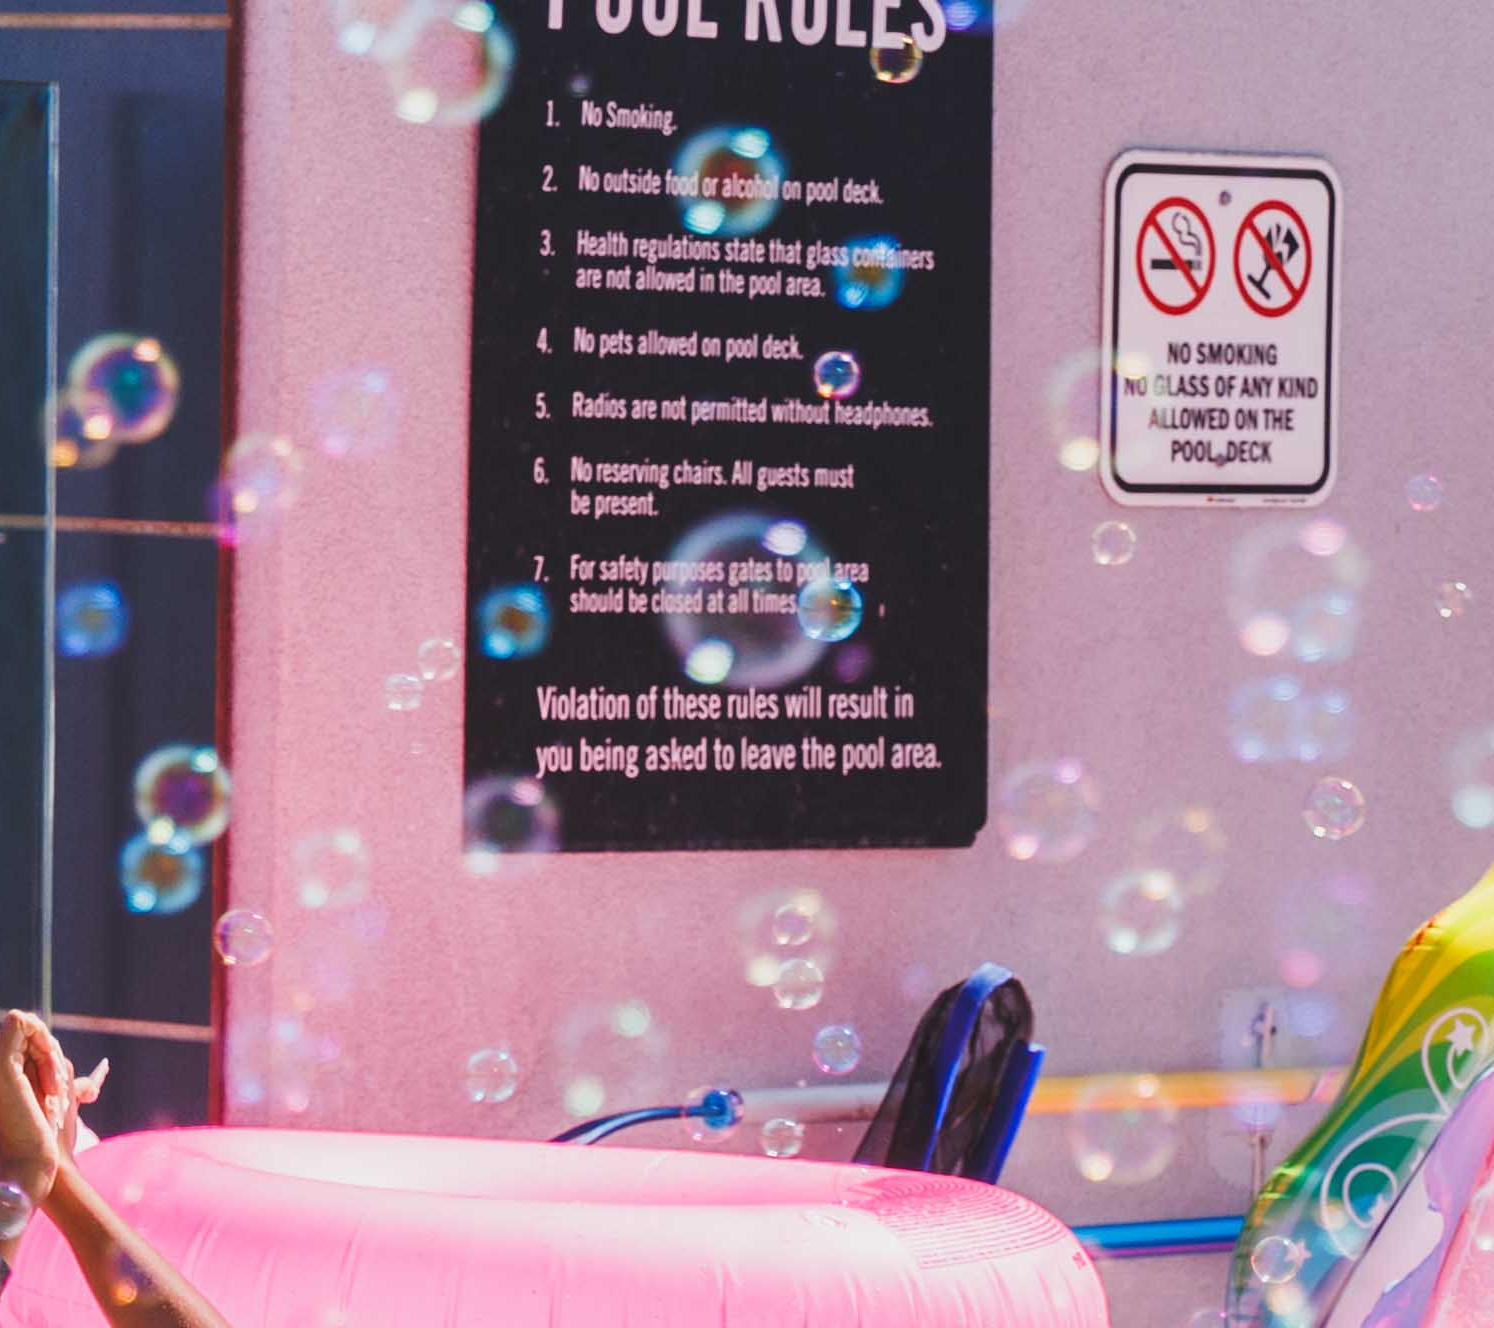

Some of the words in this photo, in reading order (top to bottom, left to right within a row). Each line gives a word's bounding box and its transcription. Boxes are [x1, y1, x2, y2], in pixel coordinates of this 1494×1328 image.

[545, 99, 560, 127] 1.
[581, 99, 603, 128] No
[605, 100, 677, 137] Smoking.
[541, 164, 558, 193] 2.
[578, 164, 600, 192] No
[602, 168, 662, 195] outside
[664, 170, 701, 201] food
[701, 176, 719, 201] or
[721, 172, 781, 203] alcohol
[779, 179, 802, 201] on
[805, 177, 839, 206] pool
[842, 178, 884, 205] deck.
[539, 229, 556, 257] 3.
[576, 229, 629, 258] Health
[632, 232, 721, 265] regulations
[724, 237, 766, 264] state
[768, 238, 803, 265] that
[805, 240, 850, 273] glass
[848, 239, 935, 273] containers
[575, 267, 603, 289] are
[605, 265, 632, 290] not
[635, 265, 696, 293] allowed
[699, 267, 715, 293] in
[718, 268, 745, 295] the
[748, 270, 782, 300] pool
[785, 276, 826, 298] area.
[536, 327, 553, 354] 4.
[573, 326, 596, 354] No
[599, 329, 634, 359] pets
[637, 329, 698, 357] allowed
[701, 336, 722, 358] on
[725, 333, 759, 363] pool
[761, 334, 804, 360] deck.
[1167, 341, 1192, 365] NO
[1196, 342, 1278, 367] SMOKING
[1124, 376, 1146, 396] NO
[1153, 375, 1209, 397] GLASS
[1215, 376, 1236, 397] OF
[1240, 377, 1274, 398] ANY
[1278, 377, 1318, 398] KIND
[535, 391, 551, 420] 5.
[572, 391, 628, 420] Radios
[630, 399, 658, 420] are
[660, 395, 687, 421] not
[690, 396, 768, 425] permitted
[770, 394, 832, 425] without
[834, 396, 933, 430] headphones.
[1148, 408, 1229, 429] ALLOWED
[1235, 409, 1257, 430] ON
[1263, 409, 1294, 430] THE
[1171, 440, 1214, 462] POOL
[1226, 441, 1272, 463] DECK
[533, 456, 549, 484] 6.
[570, 455, 593, 483] No
[595, 458, 670, 490] reserving
[672, 459, 728, 486] chairs.
[731, 459, 753, 486] All
[756, 463, 811, 492] guests
[813, 463, 855, 489] must
[570, 489, 591, 516] be
[594, 491, 659, 520] present.
[533, 555, 549, 582] 7.
[570, 553, 597, 581] For
[599, 554, 649, 586] safety
[652, 556, 725, 589] purposes
[727, 557, 774, 588] gates
[775, 557, 794, 583] to
[796, 557, 832, 588] pool
[831, 562, 869, 587] area
[569, 587, 624, 614] should
[628, 587, 649, 614] be
[651, 584, 704, 617] closed
[706, 588, 725, 614] at
[727, 587, 750, 614] all
[536, 685, 630, 721] Violation
[635, 685, 658, 720] of
[662, 685, 722, 720] these
[727, 683, 780, 720] rules
[784, 685, 822, 719] will
[828, 685, 888, 720] result
[894, 685, 914, 718] in
[532, 745, 573, 782] you
[579, 737, 640, 779] being
[645, 737, 708, 772] asked
[712, 737, 736, 771] to
[740, 736, 797, 771] leave
[800, 736, 837, 770] the
[842, 735, 885, 776] pool
[890, 743, 942, 769] area.
